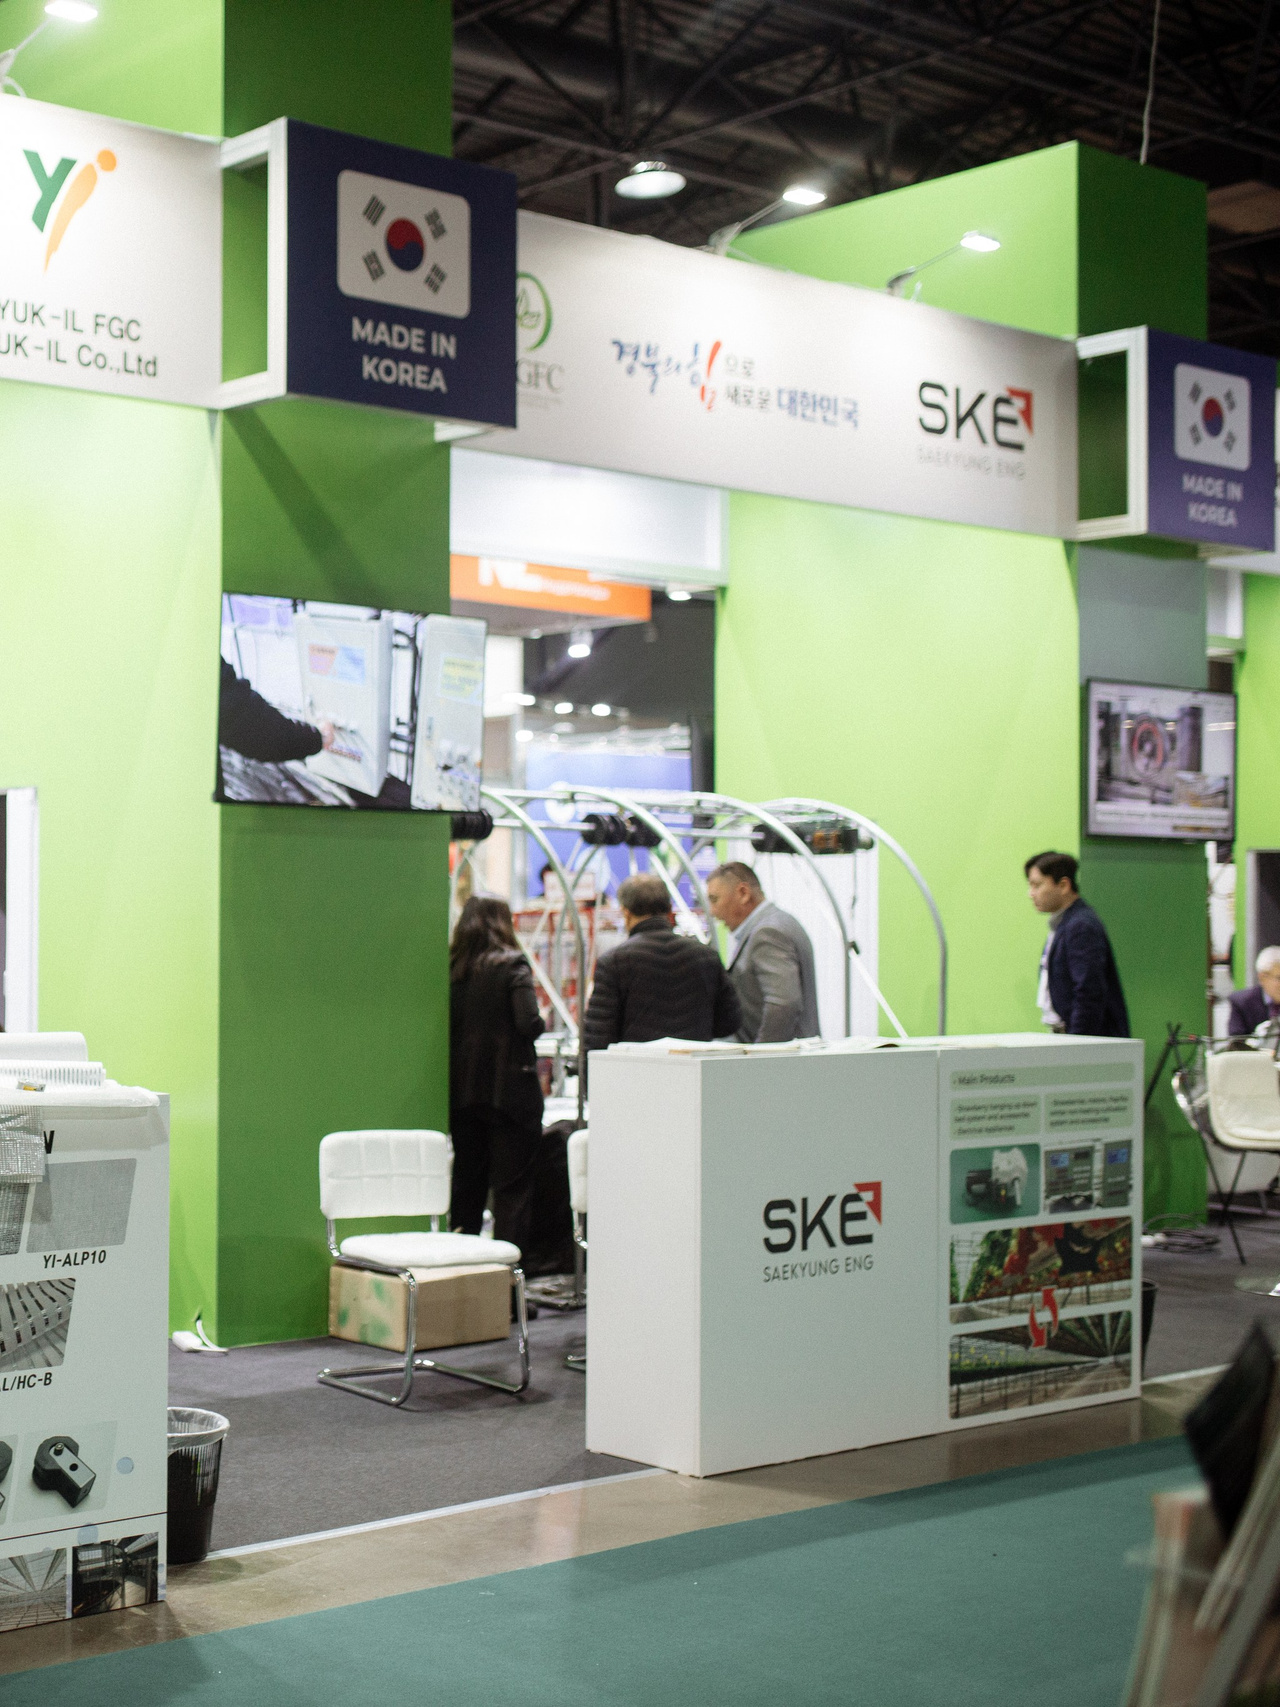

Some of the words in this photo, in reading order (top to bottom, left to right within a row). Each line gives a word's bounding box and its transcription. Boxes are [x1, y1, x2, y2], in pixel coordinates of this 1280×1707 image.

[93, 314, 142, 342] FGC
[352, 316, 425, 352] MADE
[431, 331, 456, 358] IN
[77, 344, 158, 378] Co.,Ltd
[362, 354, 448, 392] KOREA
[612, 338, 681, 394] 경북의
[726, 384, 770, 413] 새로운
[777, 388, 859, 430] 대한민국
[918, 381, 1025, 452] SKE
[1182, 473, 1225, 499] MADE
[1227, 482, 1244, 502] IN
[1188, 502, 1239, 529] KOREA
[958, 1076, 977, 1086] Main
[980, 1073, 1016, 1084] Products
[763, 1192, 873, 1254] SKE
[42, 1249, 107, 1270] YI-ALP10
[762, 1258, 840, 1283] SAEKYUNG
[844, 1254, 874, 1273] ENG
